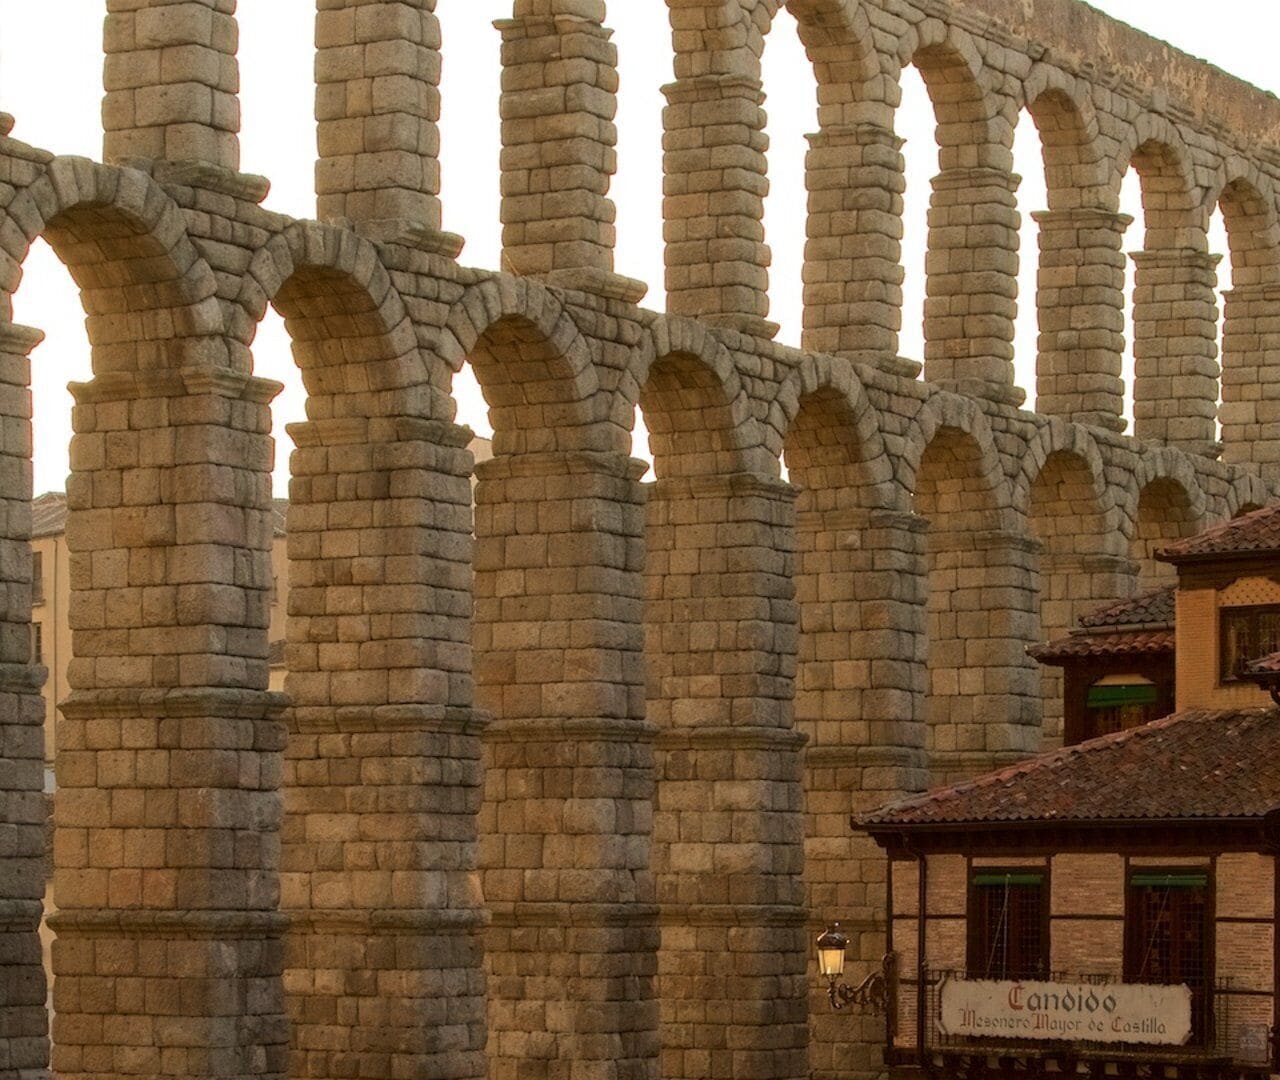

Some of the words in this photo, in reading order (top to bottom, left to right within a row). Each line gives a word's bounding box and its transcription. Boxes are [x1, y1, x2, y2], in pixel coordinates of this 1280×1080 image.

[1008, 986, 1117, 1013] Candido
[959, 1006, 1030, 1030] Mesonero
[1031, 1012, 1082, 1035] Mayor
[1088, 1019, 1104, 1033] de
[1111, 1016, 1167, 1035] Castilla
